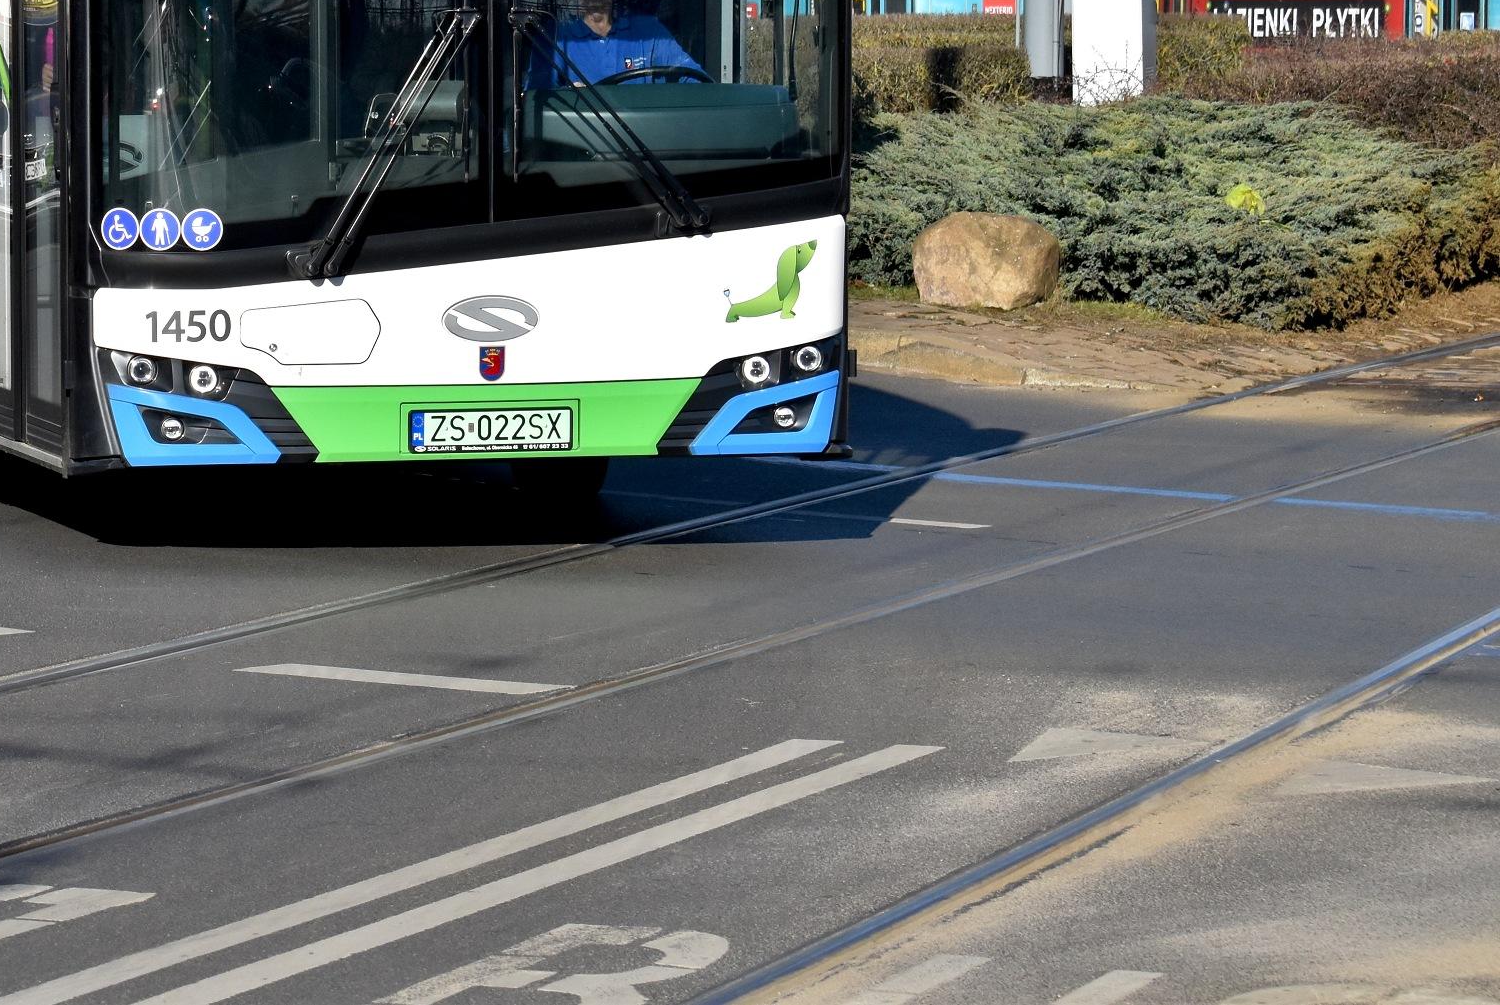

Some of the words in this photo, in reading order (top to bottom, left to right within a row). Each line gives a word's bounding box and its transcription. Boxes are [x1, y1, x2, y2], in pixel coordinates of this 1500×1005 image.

[1312, 7, 1380, 38] PŁYTKI
[145, 308, 232, 343] 1450
[412, 432, 424, 441] PL
[430, 415, 466, 442] ZS
[477, 412, 562, 441] 022SX
